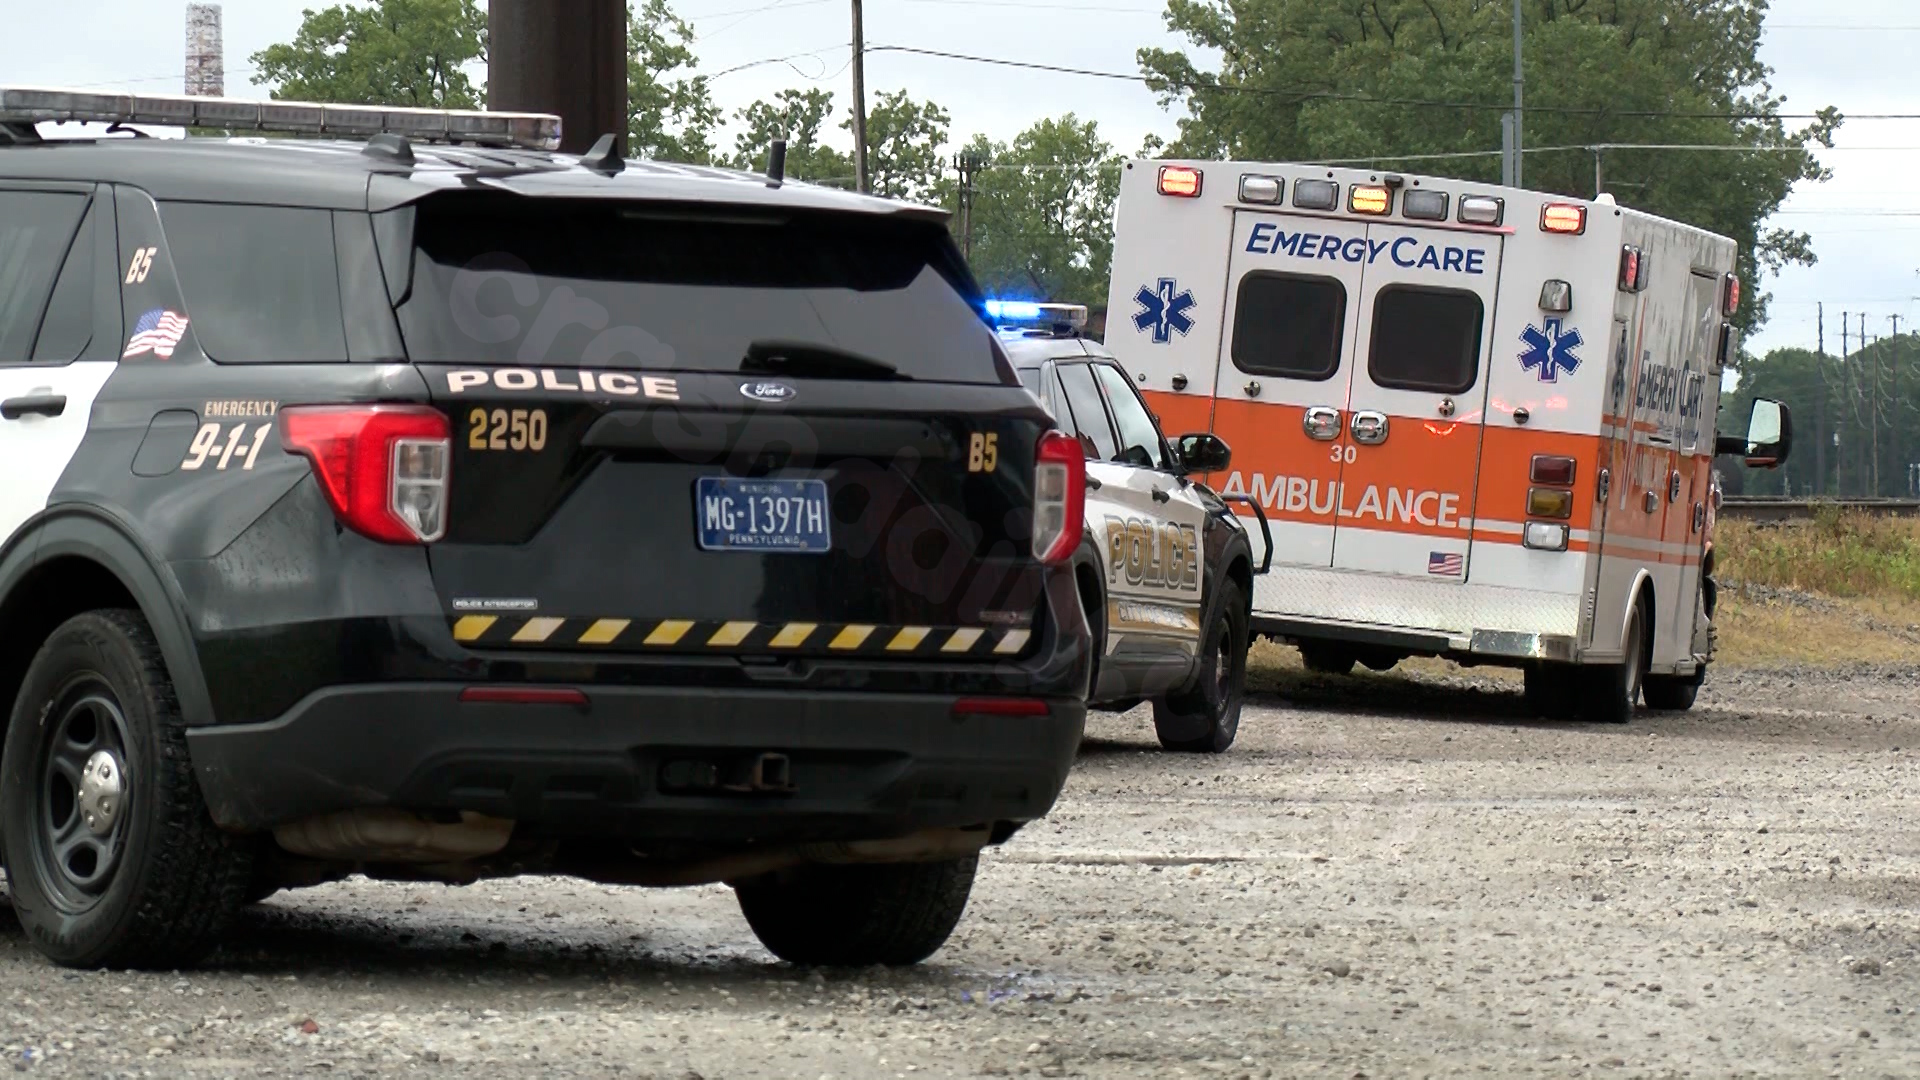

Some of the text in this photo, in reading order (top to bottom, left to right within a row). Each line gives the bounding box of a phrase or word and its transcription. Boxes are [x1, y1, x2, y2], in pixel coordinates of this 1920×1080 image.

[125, 247, 157, 284] B5
[446, 368, 680, 400] POLICE
[755, 383, 785, 397] Ford
[204, 400, 279, 418] EMERGENCY
[181, 422, 272, 470] 9-1-1
[468, 407, 547, 450] 2250
[968, 431, 998, 473] B5
[1330, 444, 1357, 464] 30
[705, 495, 823, 535] MG-1397H
[1221, 471, 1460, 528] AMBULANCE
[729, 534, 800, 546] PENNSYLVANIA
[1104, 513, 1197, 592] POLICE
